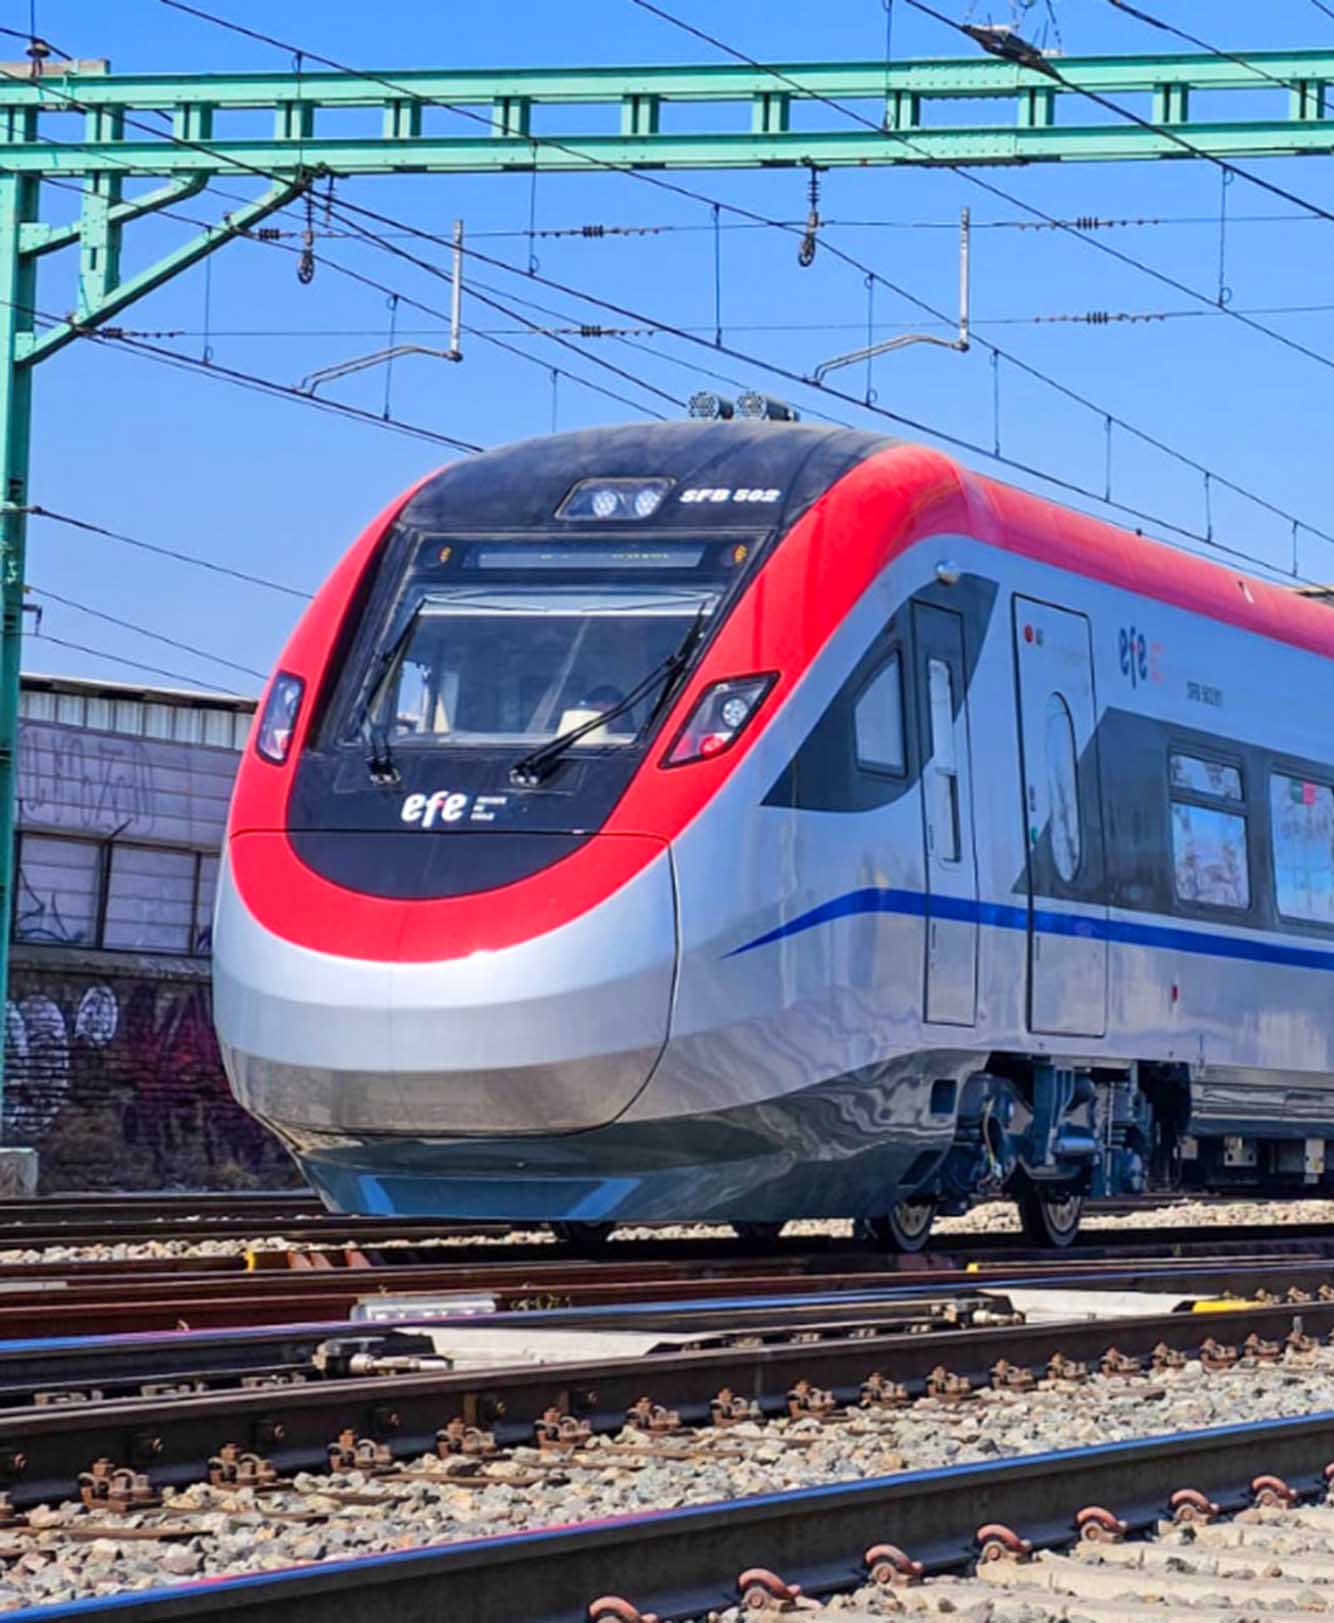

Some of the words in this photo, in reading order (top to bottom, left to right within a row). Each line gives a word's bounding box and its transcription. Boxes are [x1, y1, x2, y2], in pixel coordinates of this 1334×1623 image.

[680, 488, 730, 502] SFB
[732, 488, 781, 502] 502
[1119, 626, 1147, 689] efe
[401, 791, 467, 828] efe
